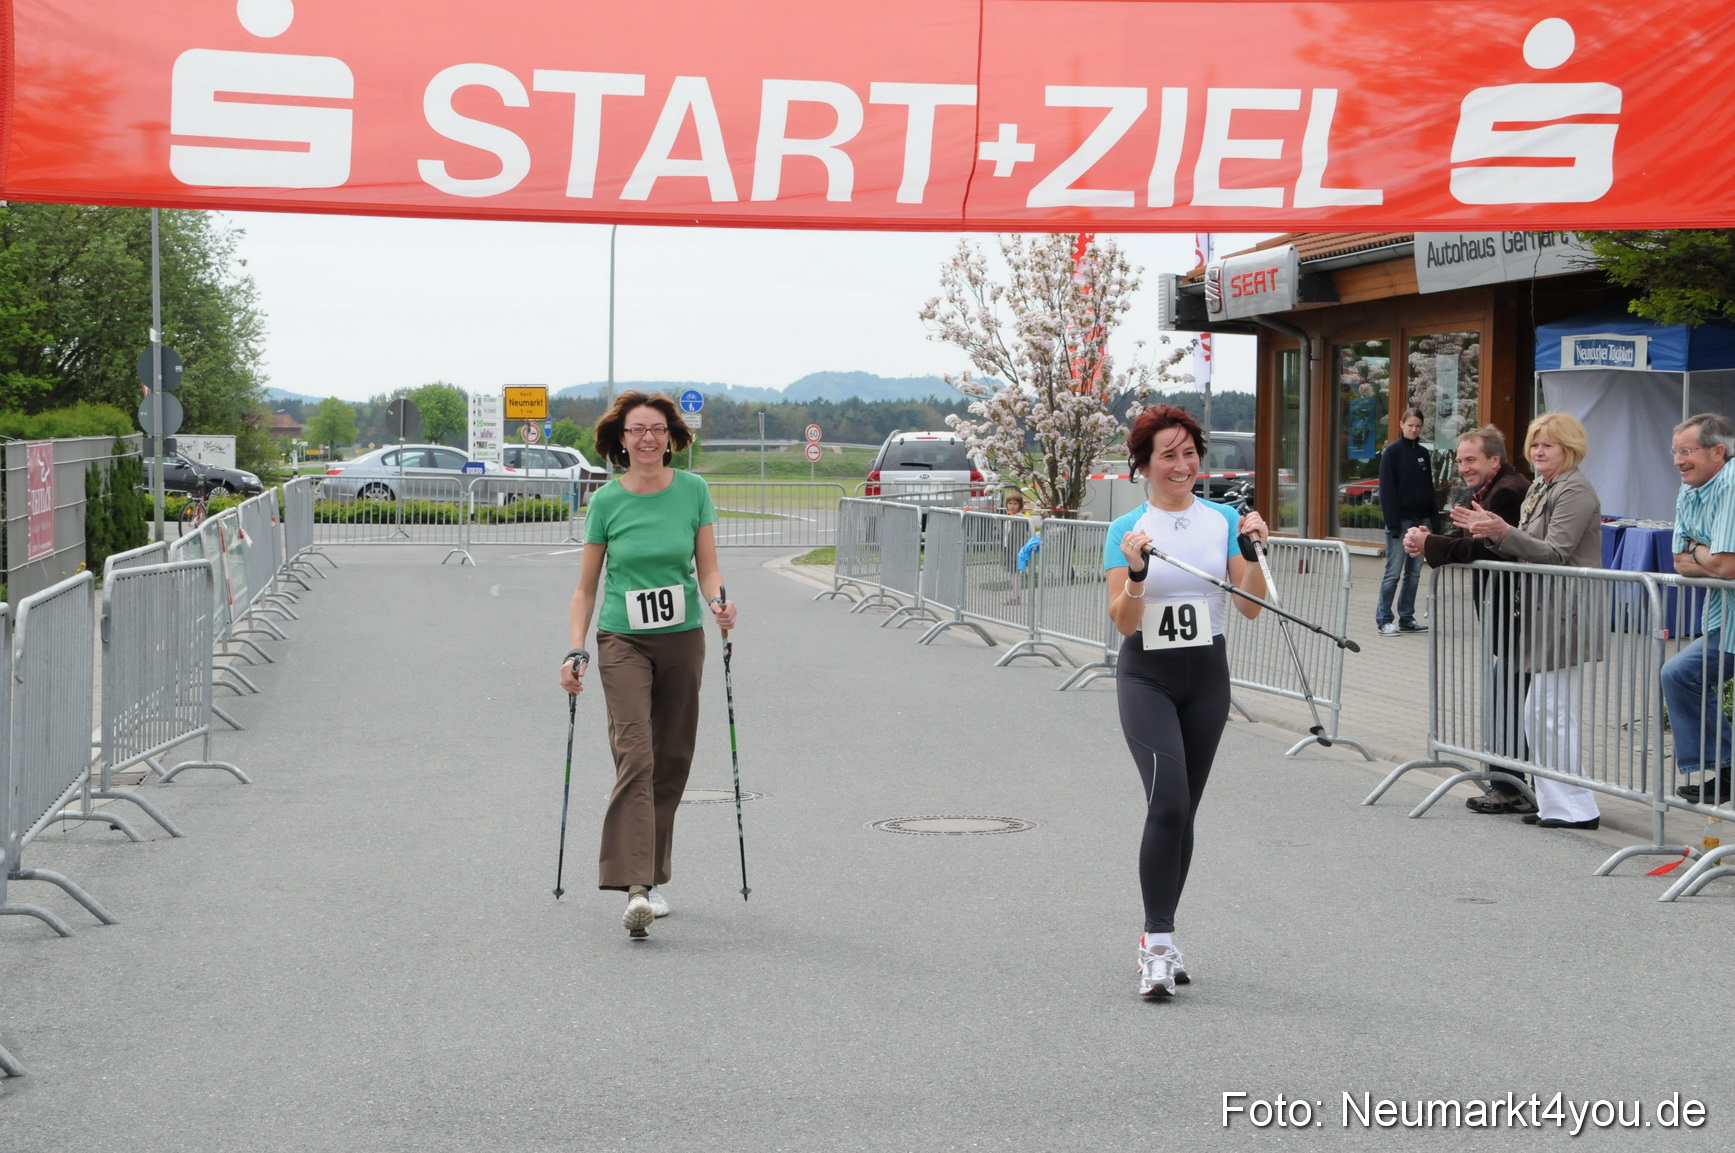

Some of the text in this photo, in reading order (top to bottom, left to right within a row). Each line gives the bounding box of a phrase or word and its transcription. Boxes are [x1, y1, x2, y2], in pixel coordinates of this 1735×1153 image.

[1427, 234, 1496, 268] Autohaus
[1231, 267, 1279, 298] SEAT
[509, 398, 543, 406] Neumarkt
[810, 430, 818, 438] 60
[636, 589, 675, 624] 119
[1158, 603, 1198, 642] 49
